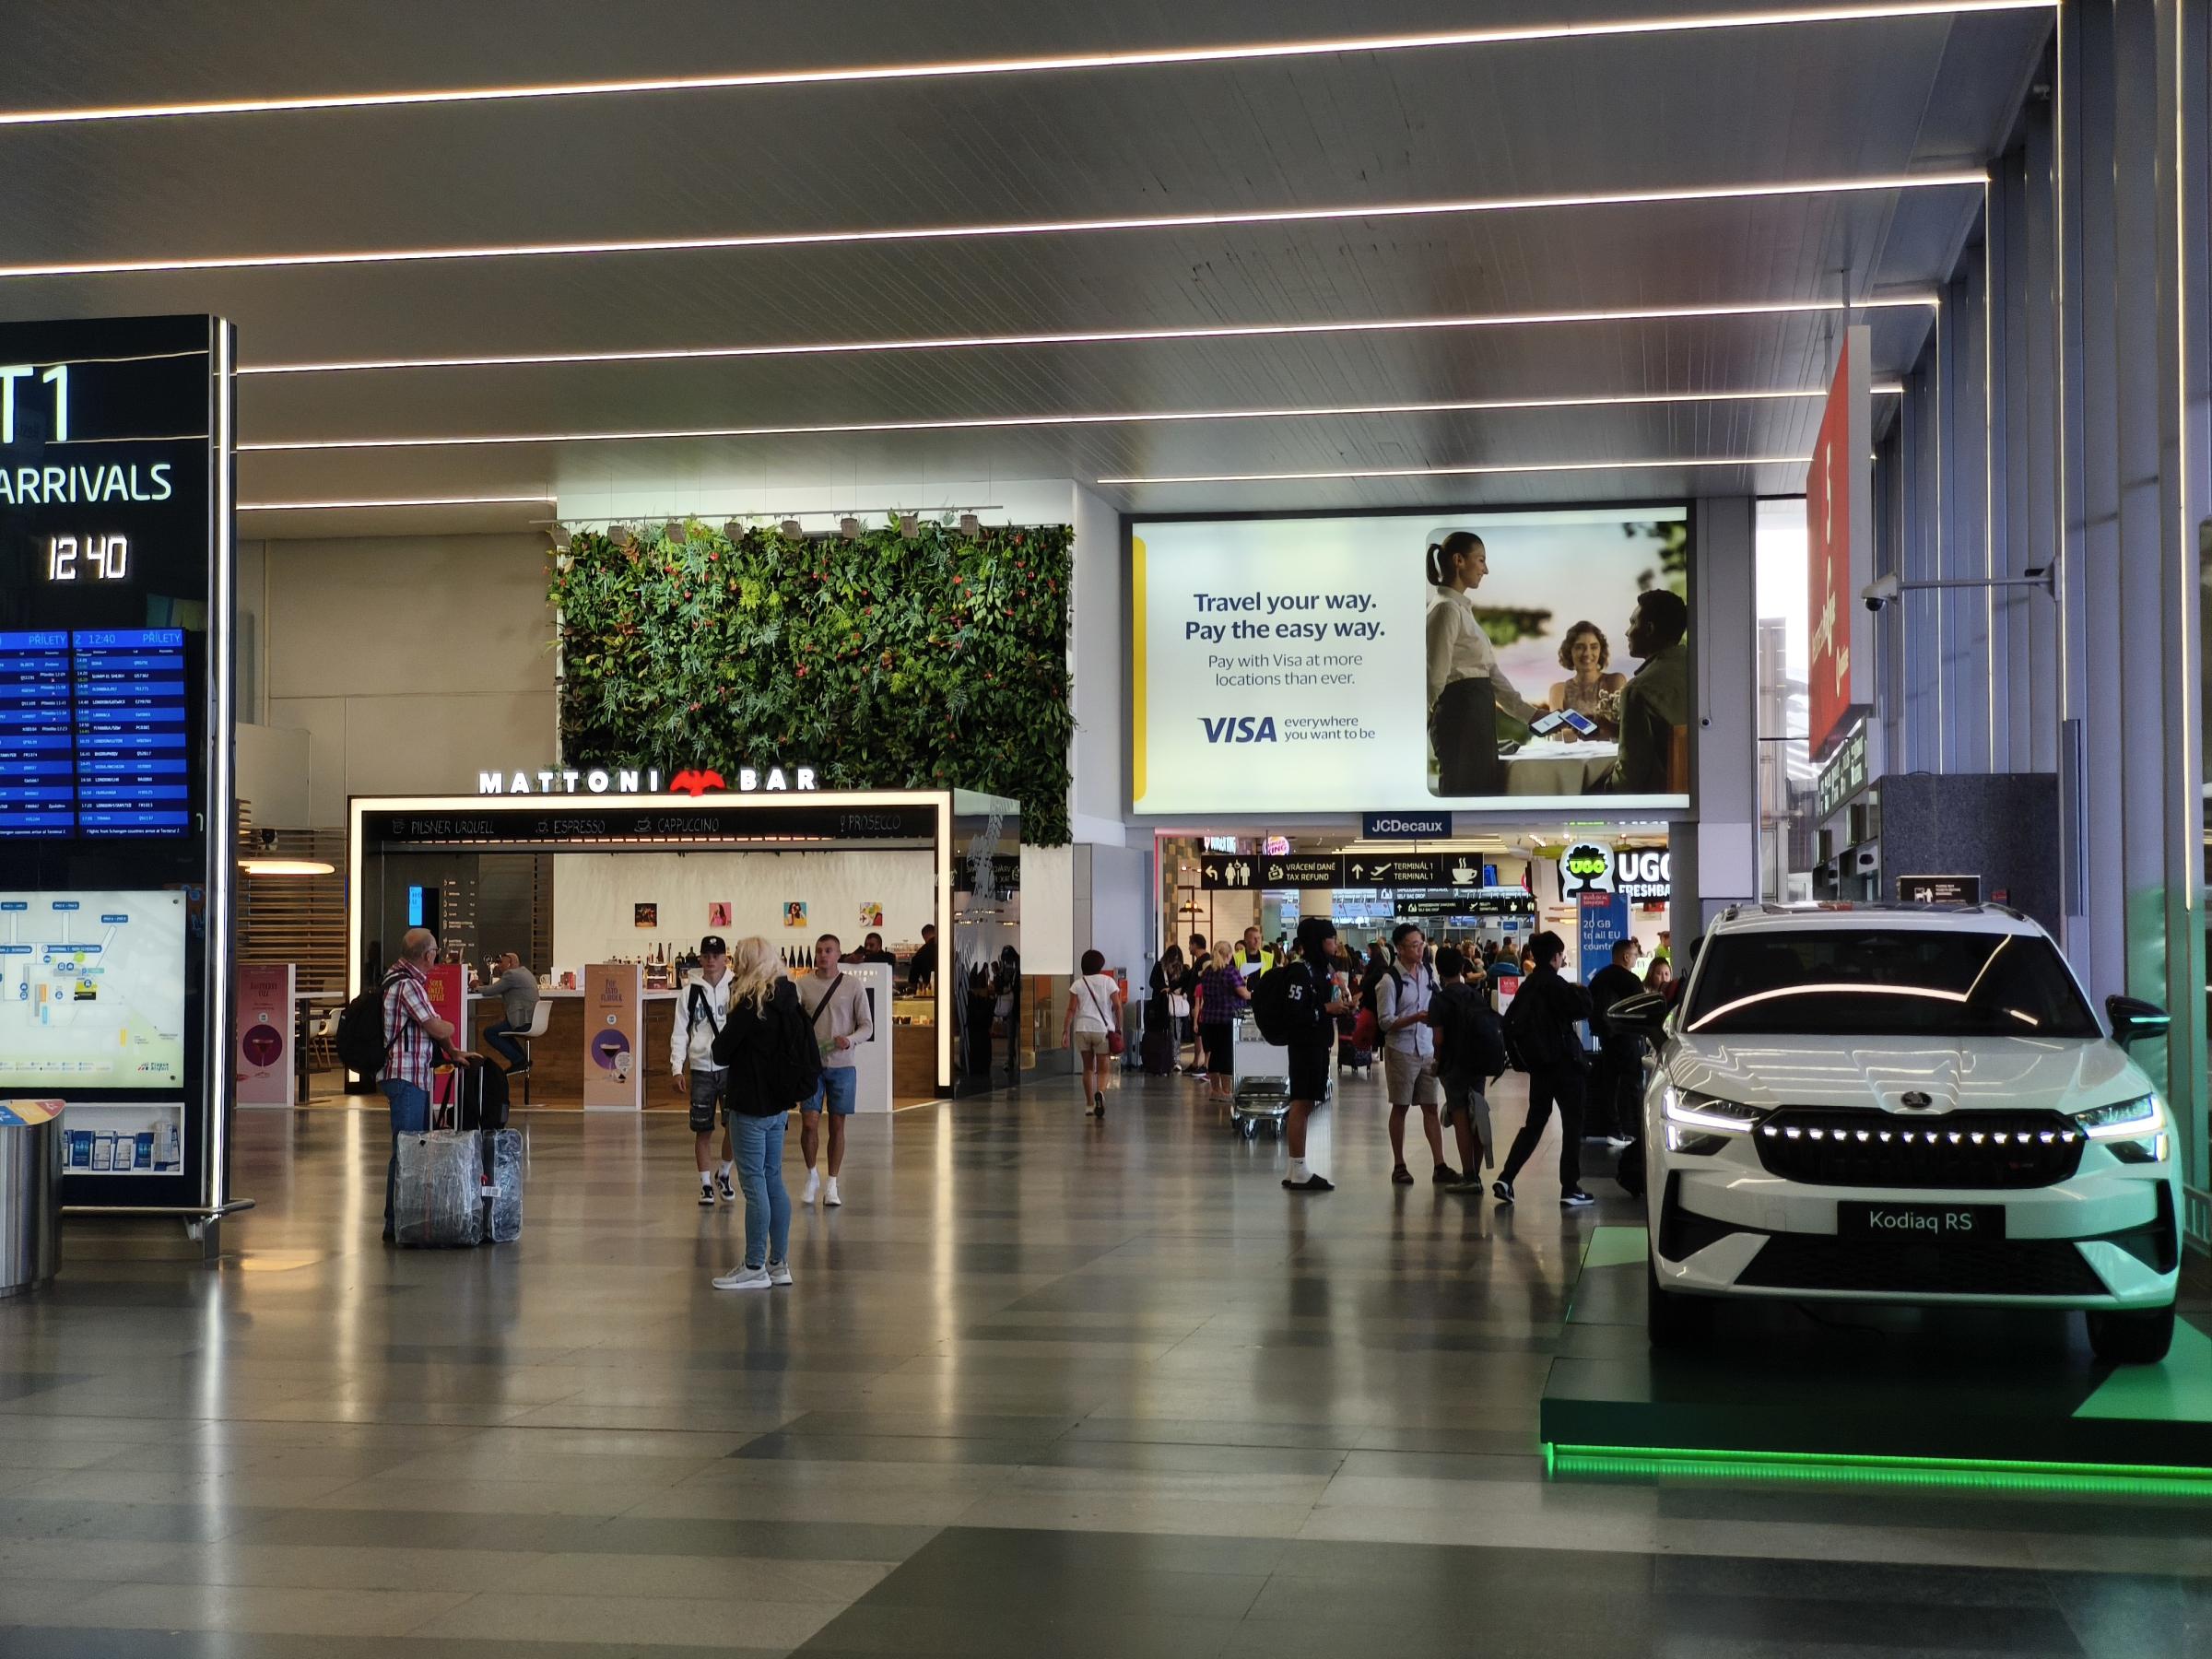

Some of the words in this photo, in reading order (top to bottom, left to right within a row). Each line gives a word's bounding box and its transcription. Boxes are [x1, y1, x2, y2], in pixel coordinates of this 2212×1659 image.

[0, 365, 67, 443] T1
[0, 464, 172, 504] ARRIVALS
[1194, 592, 1261, 613] Travel
[1266, 594, 1320, 615] your
[1325, 593, 1377, 613] way.
[89, 634, 116, 644] 12:40
[1185, 620, 1227, 643] Pay
[1231, 620, 1270, 639] the
[1275, 621, 1328, 641] easy
[1334, 620, 1385, 641] way.
[1208, 654, 1234, 670] Pay
[1238, 653, 1269, 668] with
[1273, 653, 1302, 667] Visa
[1306, 654, 1320, 666] at
[1324, 654, 1363, 666] more
[1216, 673, 1281, 687] locations
[1285, 672, 1317, 685] than
[1321, 673, 1356, 685] ever.
[1197, 716, 1277, 743] VISA
[1284, 716, 1359, 729] everywhere
[1284, 730, 1309, 740] you
[1310, 728, 1341, 740] want
[1344, 729, 1358, 739] to
[1359, 728, 1376, 739] be
[478, 771, 658, 794] MATTONI
[740, 769, 816, 792] BAR
[411, 819, 452, 835] PILSNER
[554, 819, 606, 834] ESPRESSO
[657, 818, 720, 832] CAPPUCCINO
[849, 815, 901, 830] PROSECCO
[1372, 819, 1442, 832] JCDecaux
[1286, 862, 1316, 872] VRÁCENÍ
[1317, 862, 1335, 871] DANĚ
[1394, 861, 1429, 870] TERMINÁL
[1430, 862, 1434, 870] 1
[1570, 859, 1606, 874] UGO
[1300, 873, 1329, 881] REFUND
[1394, 872, 1429, 880] TERMINAL
[1430, 872, 1434, 880] 1
[1583, 920, 1594, 928] 20
[1597, 920, 1611, 928] GB
[1583, 931, 1593, 939] to
[1595, 930, 1606, 939] all
[1608, 931, 1620, 939] EU
[1583, 942, 1612, 950] countr
[1870, 1211, 1938, 1234] Kodiaq
[1946, 1213, 1972, 1230] RS
